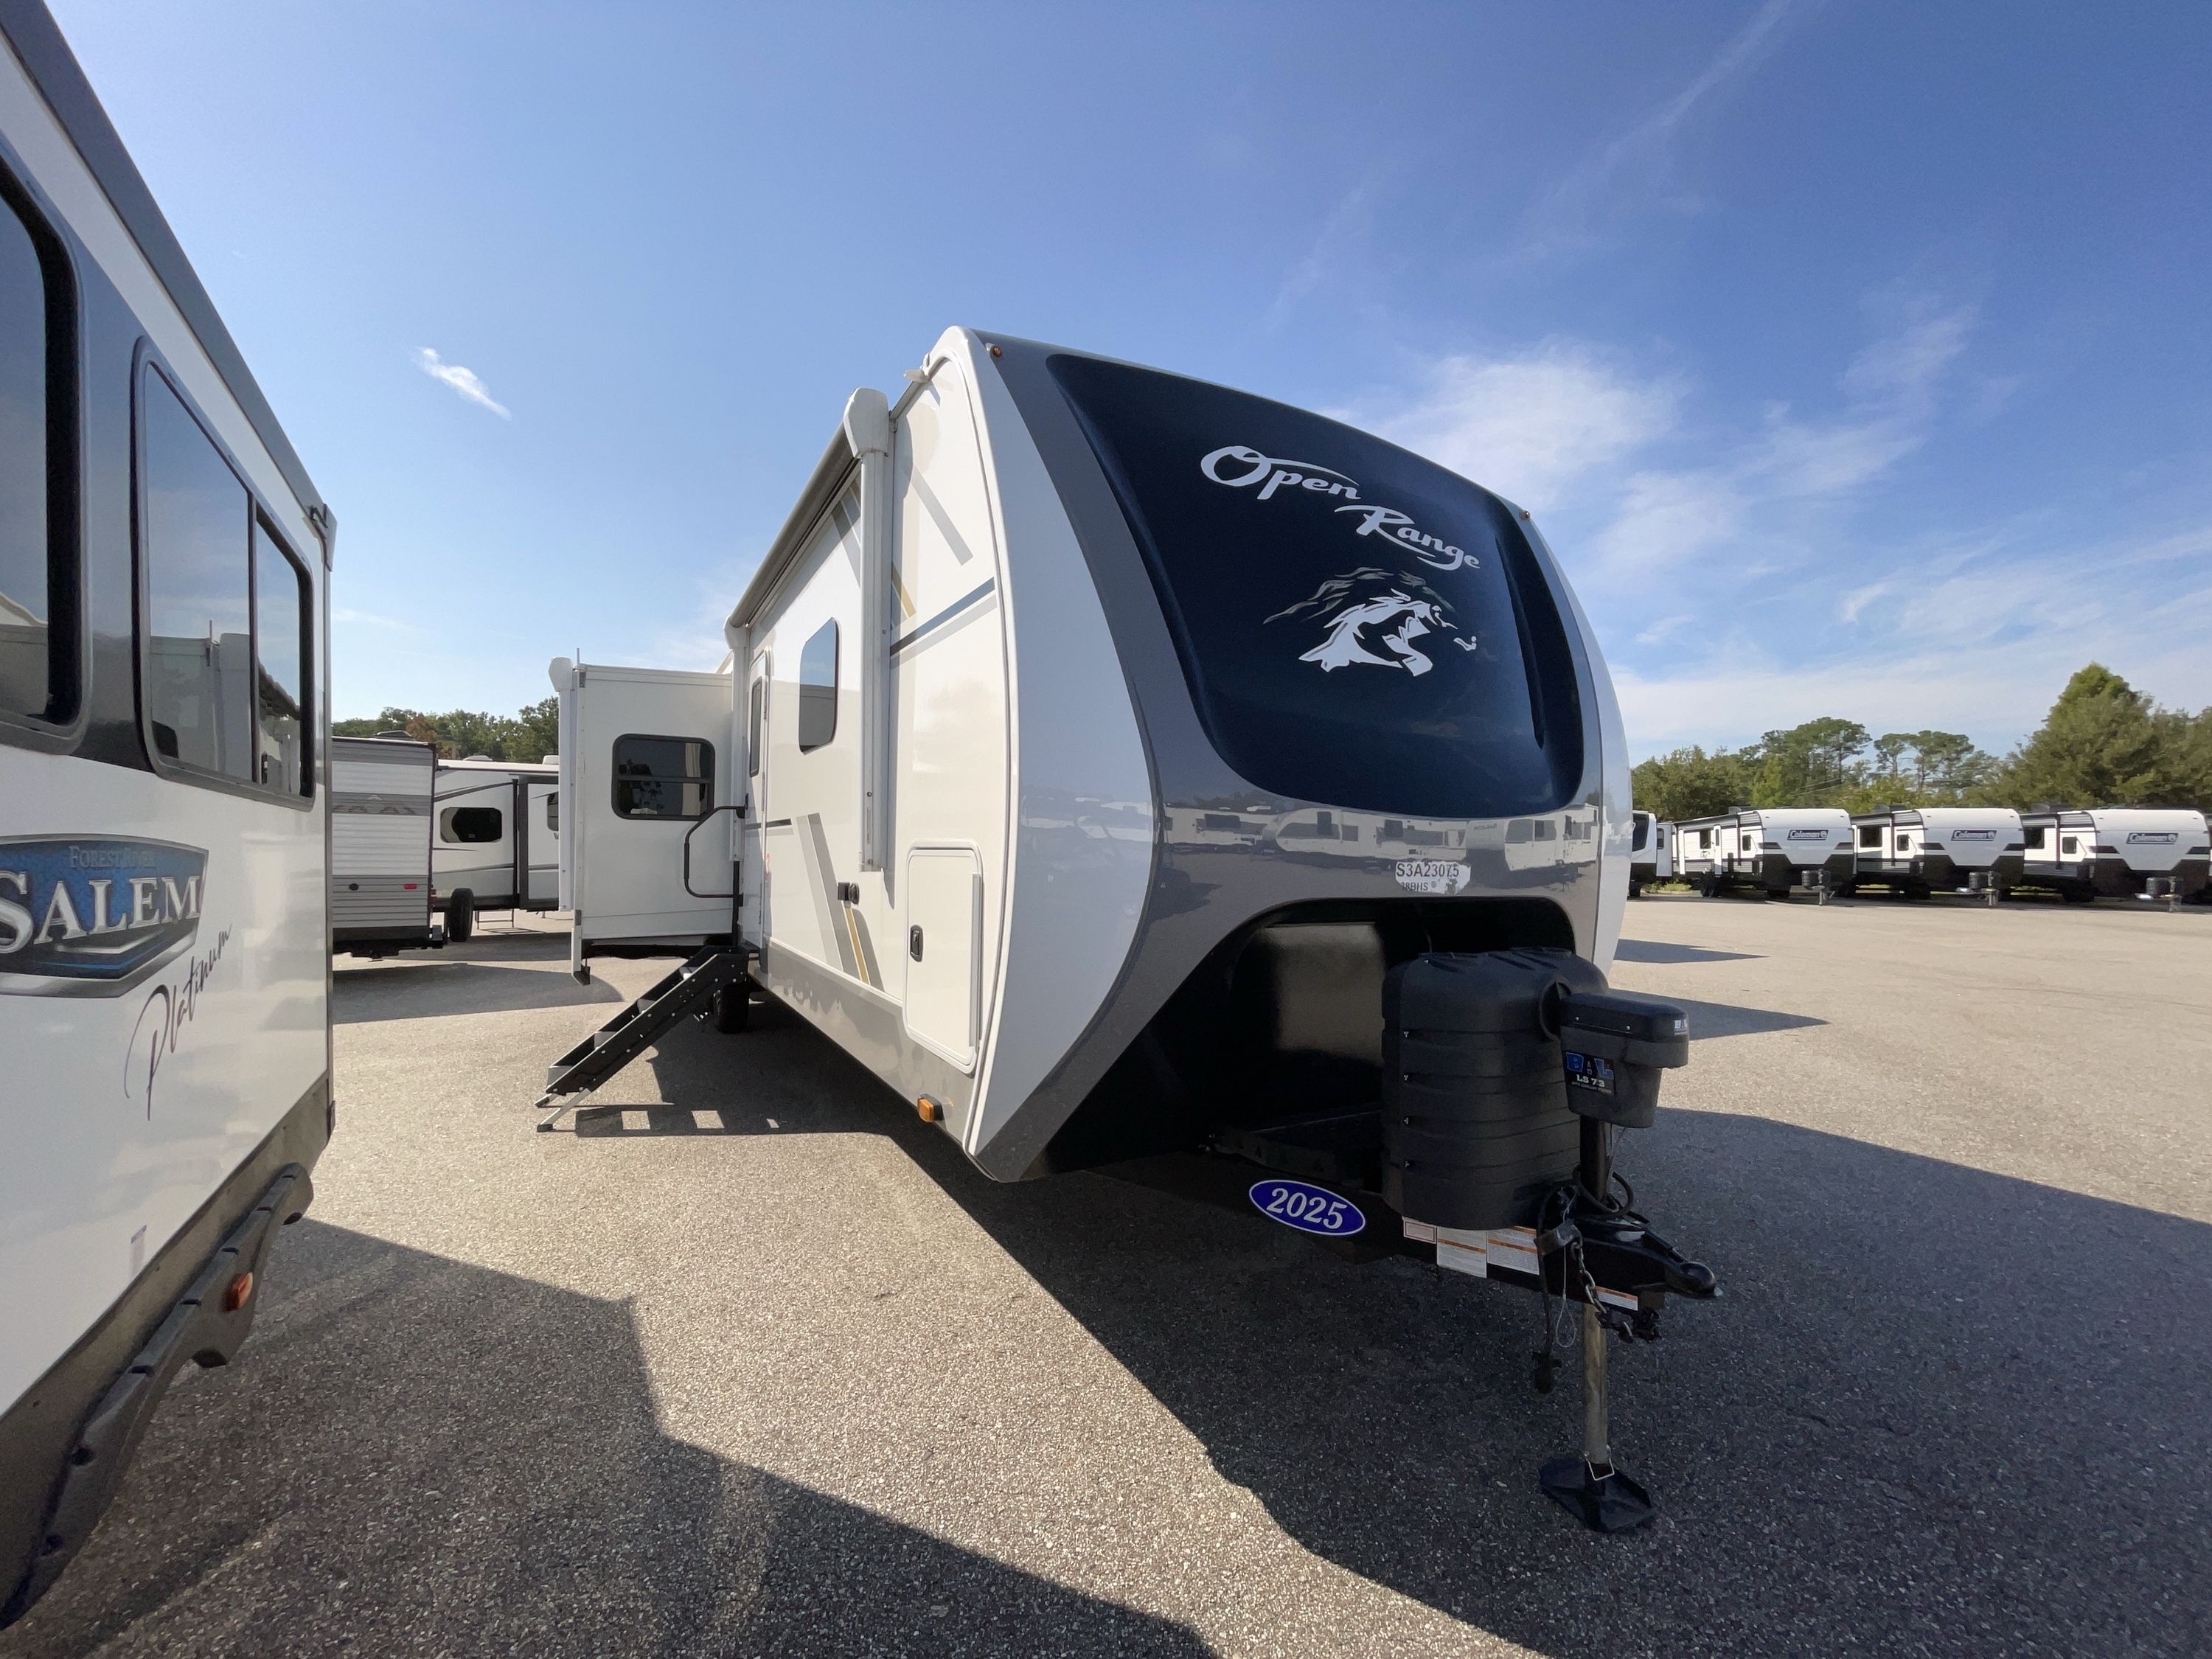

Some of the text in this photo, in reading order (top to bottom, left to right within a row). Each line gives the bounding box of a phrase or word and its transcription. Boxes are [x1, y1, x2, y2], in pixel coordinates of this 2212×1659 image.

[1200, 445, 1361, 500] Open
[1334, 504, 1481, 571] Range
[1790, 830, 1820, 838] Coleman
[1953, 830, 1988, 838] Coleman
[1397, 863, 1459, 877] S3A23075
[0, 871, 200, 954] SALEM
[124, 923, 232, 1121] Platinum
[1576, 1074, 1589, 1084] LS
[1266, 1187, 1348, 1229] 2025
